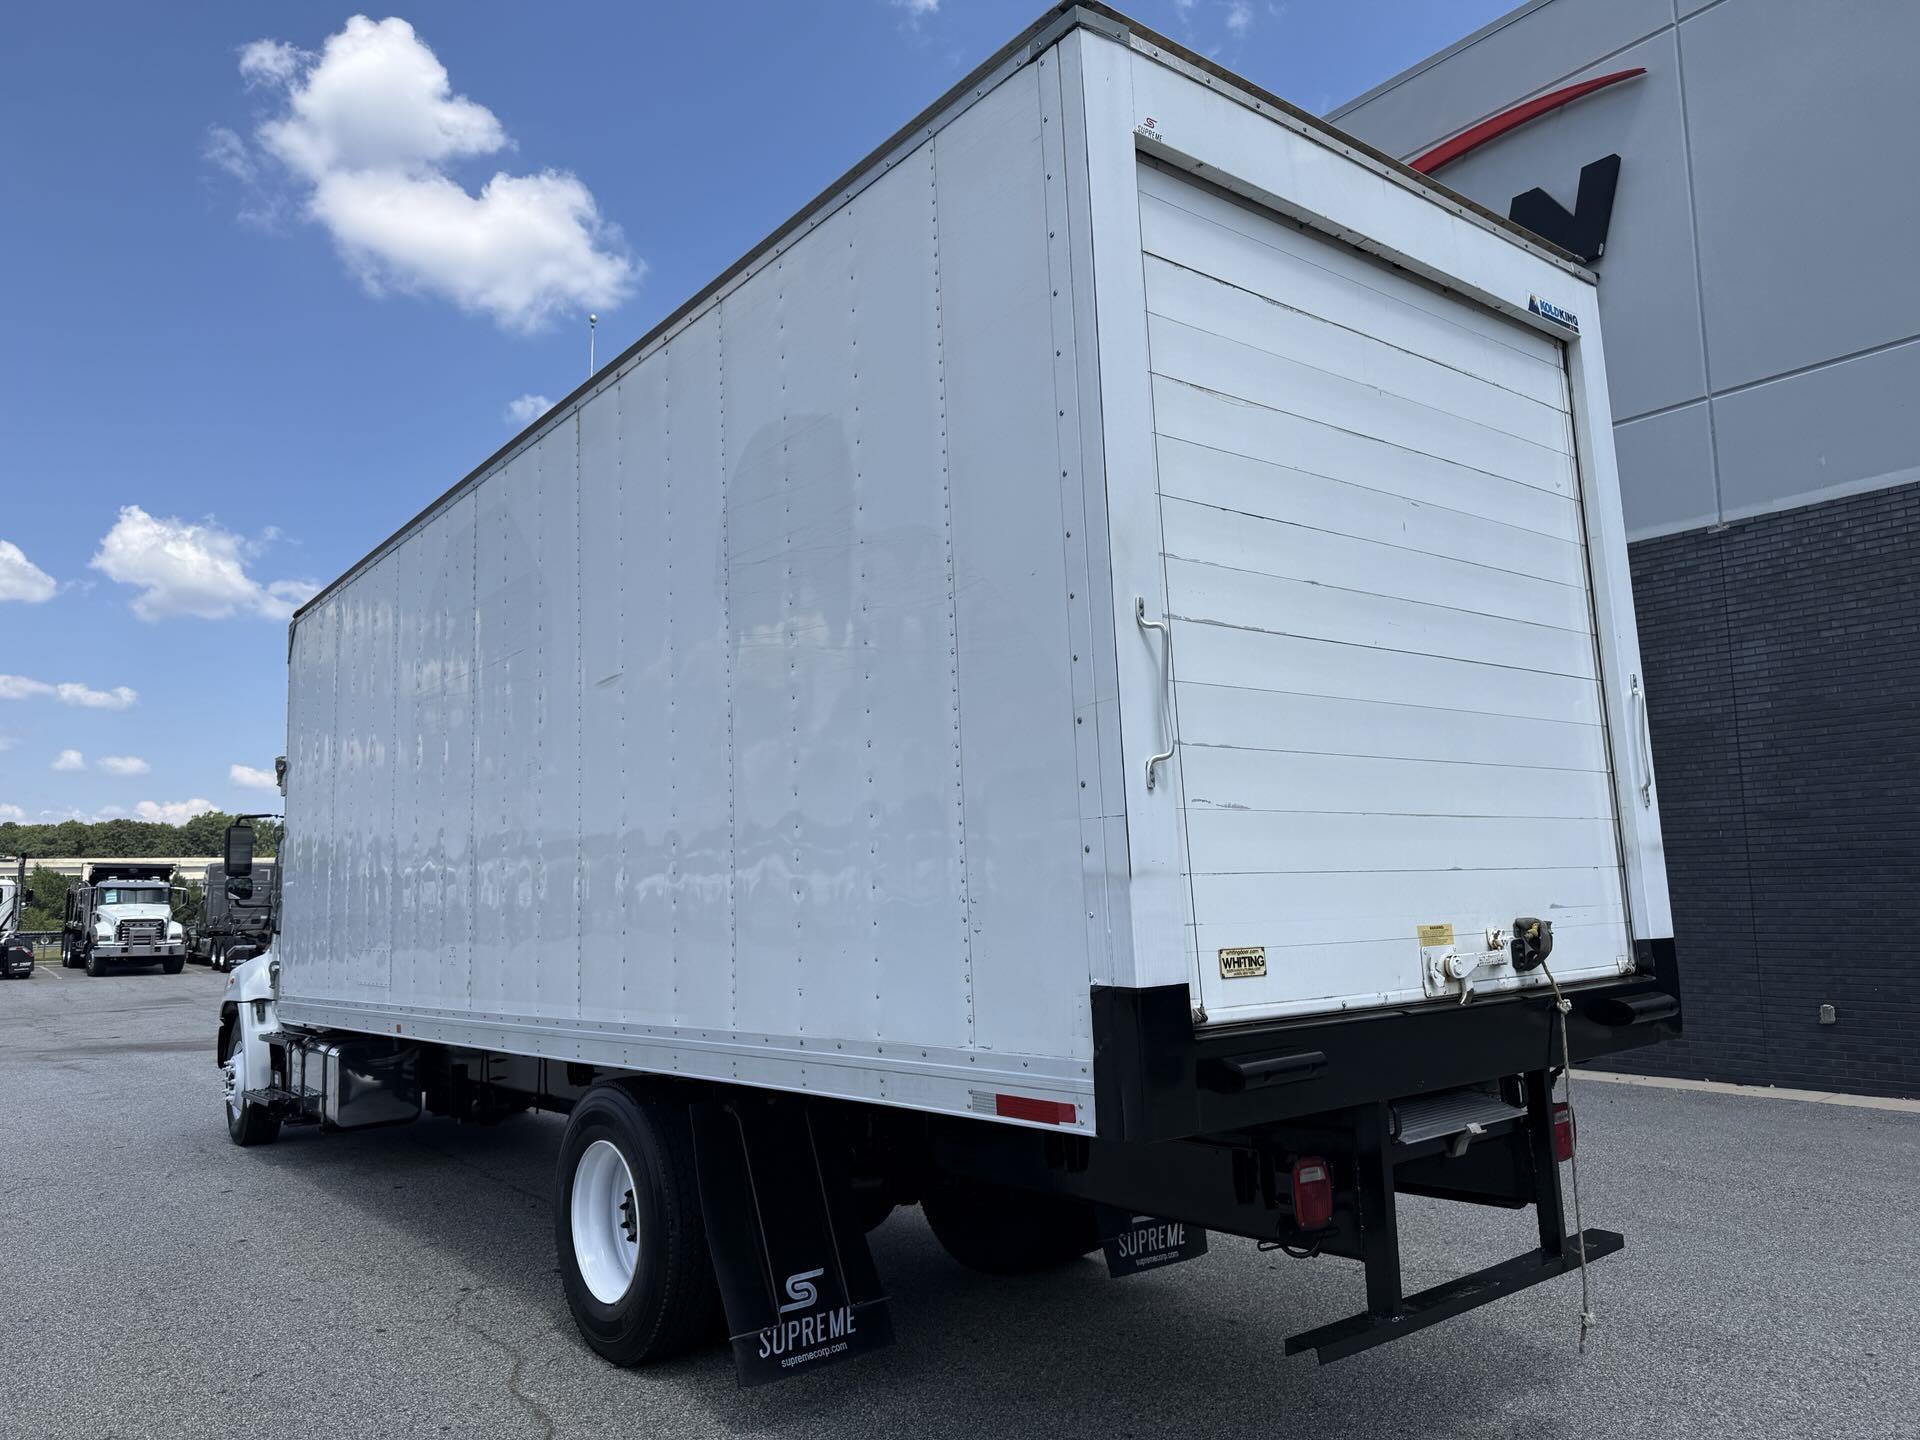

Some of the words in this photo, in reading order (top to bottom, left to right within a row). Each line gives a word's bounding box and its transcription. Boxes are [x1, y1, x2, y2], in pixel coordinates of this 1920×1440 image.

[1137, 124, 1163, 142] SUPREME
[1221, 955, 1265, 969] WHITING
[1118, 1222, 1186, 1258] SUPREME
[759, 1305, 857, 1359] SUPREME
[781, 1341, 848, 1368] supremecorp.com
